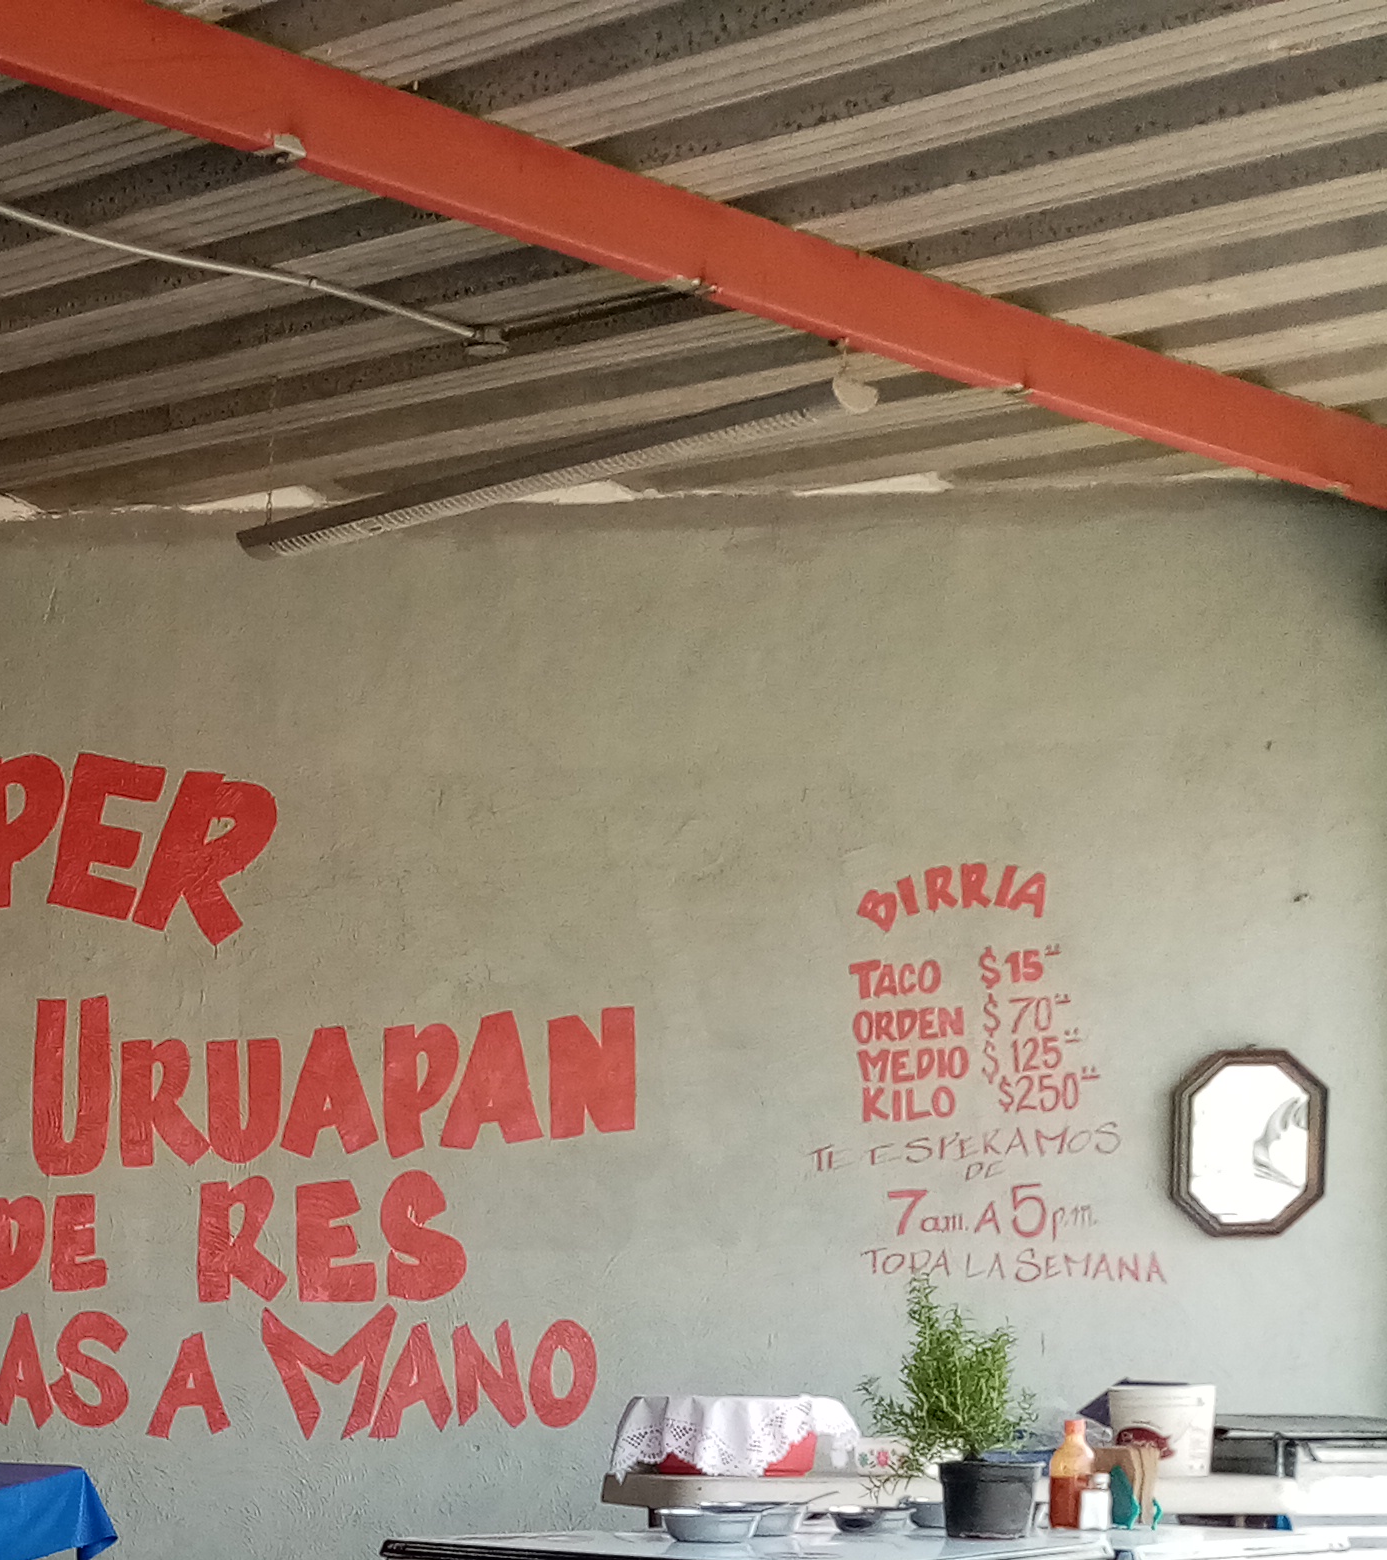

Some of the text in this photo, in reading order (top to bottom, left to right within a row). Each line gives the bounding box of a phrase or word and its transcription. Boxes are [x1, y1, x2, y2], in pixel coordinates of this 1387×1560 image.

[857, 862, 1046, 932] BIRRIA
[849, 959, 942, 1000] TACO
[852, 1006, 965, 1044] ORDEN
[857, 1045, 970, 1084] MEDIO
[31, 995, 637, 1176] URUAPAN
[861, 1085, 957, 1122] KILO
[866, 1121, 1122, 1166] ESPERAMOS
[965, 1160, 1004, 1182] DE
[197, 1169, 467, 1303] RES
[973, 1201, 1002, 1235] A
[860, 1247, 1168, 1285] TODA LA SEMANA
[147, 1331, 231, 1439] A
[260, 1304, 598, 1439] MANO
